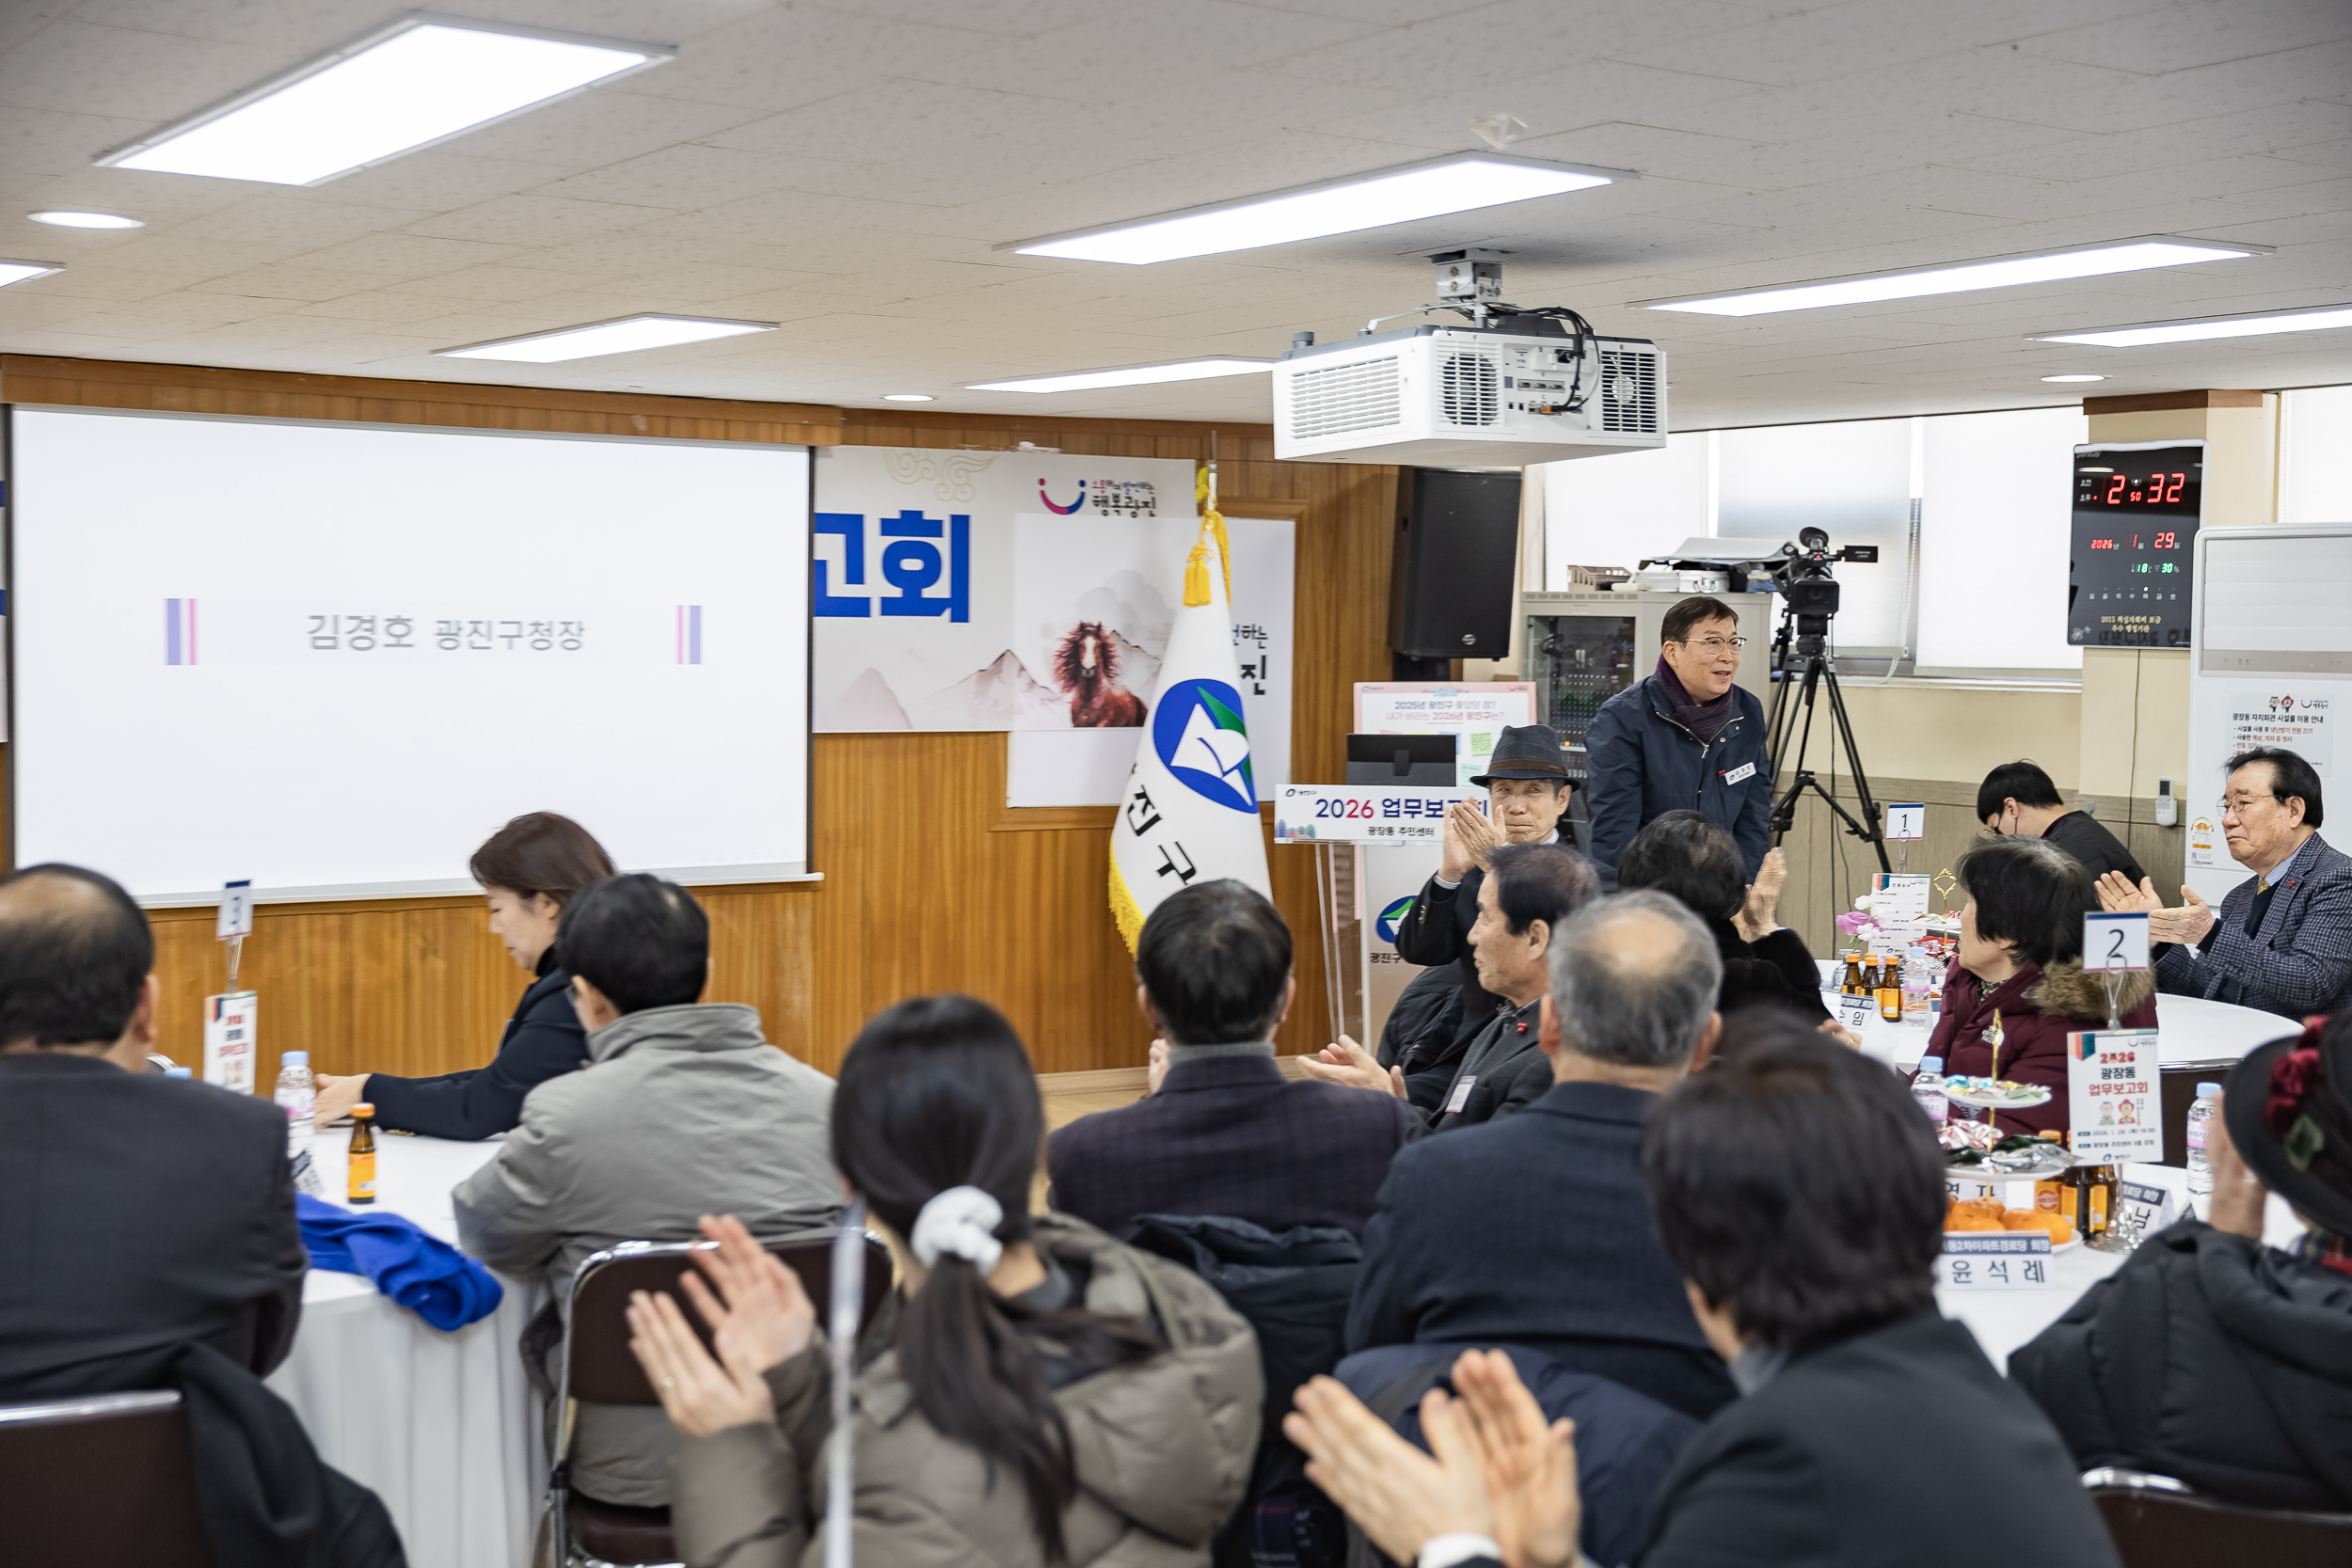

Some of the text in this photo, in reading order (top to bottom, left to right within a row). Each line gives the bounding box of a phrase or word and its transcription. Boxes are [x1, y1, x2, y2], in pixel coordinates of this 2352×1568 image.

[2107, 472, 2185, 505] 2 32
[1091, 493, 1156, 518] 행복광진
[308, 614, 585, 651] 김경호 광진구청장
[1315, 798, 1488, 819] 2026 업무보
[1397, 827, 1435, 837] 주민센터
[1900, 813, 1908, 832] 1
[2107, 928, 2125, 958] 2
[2101, 1066, 2136, 1080] 광장동
[2089, 1081, 2148, 1096] 업무보고회
